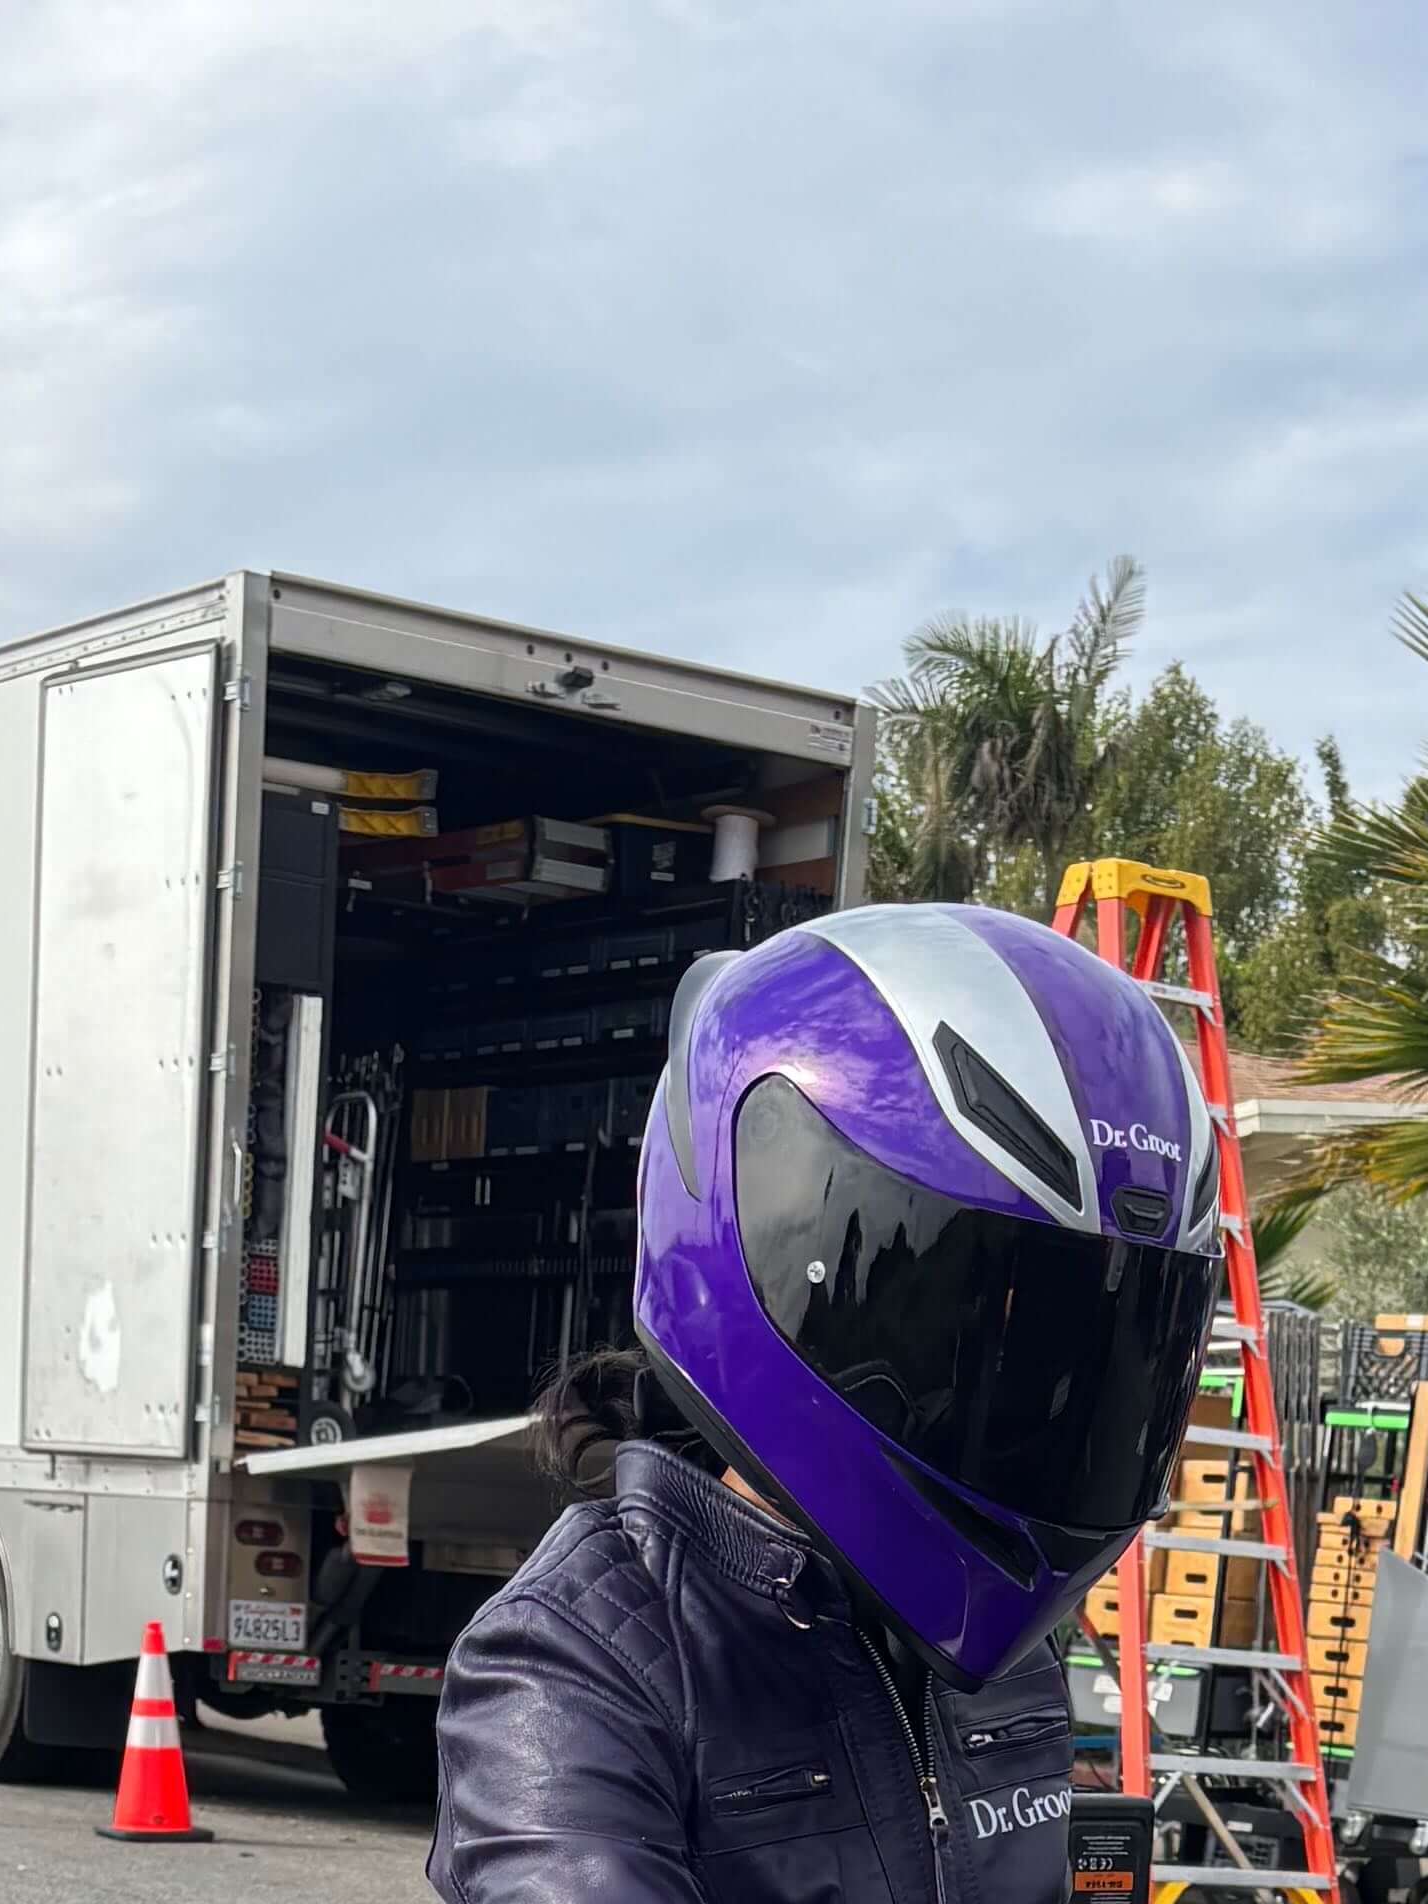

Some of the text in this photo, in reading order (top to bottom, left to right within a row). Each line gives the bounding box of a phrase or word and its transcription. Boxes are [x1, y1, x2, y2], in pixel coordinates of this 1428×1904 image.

[1090, 1119, 1182, 1162] Dr. Groot
[969, 1787, 1073, 1839] Dr. Groo
